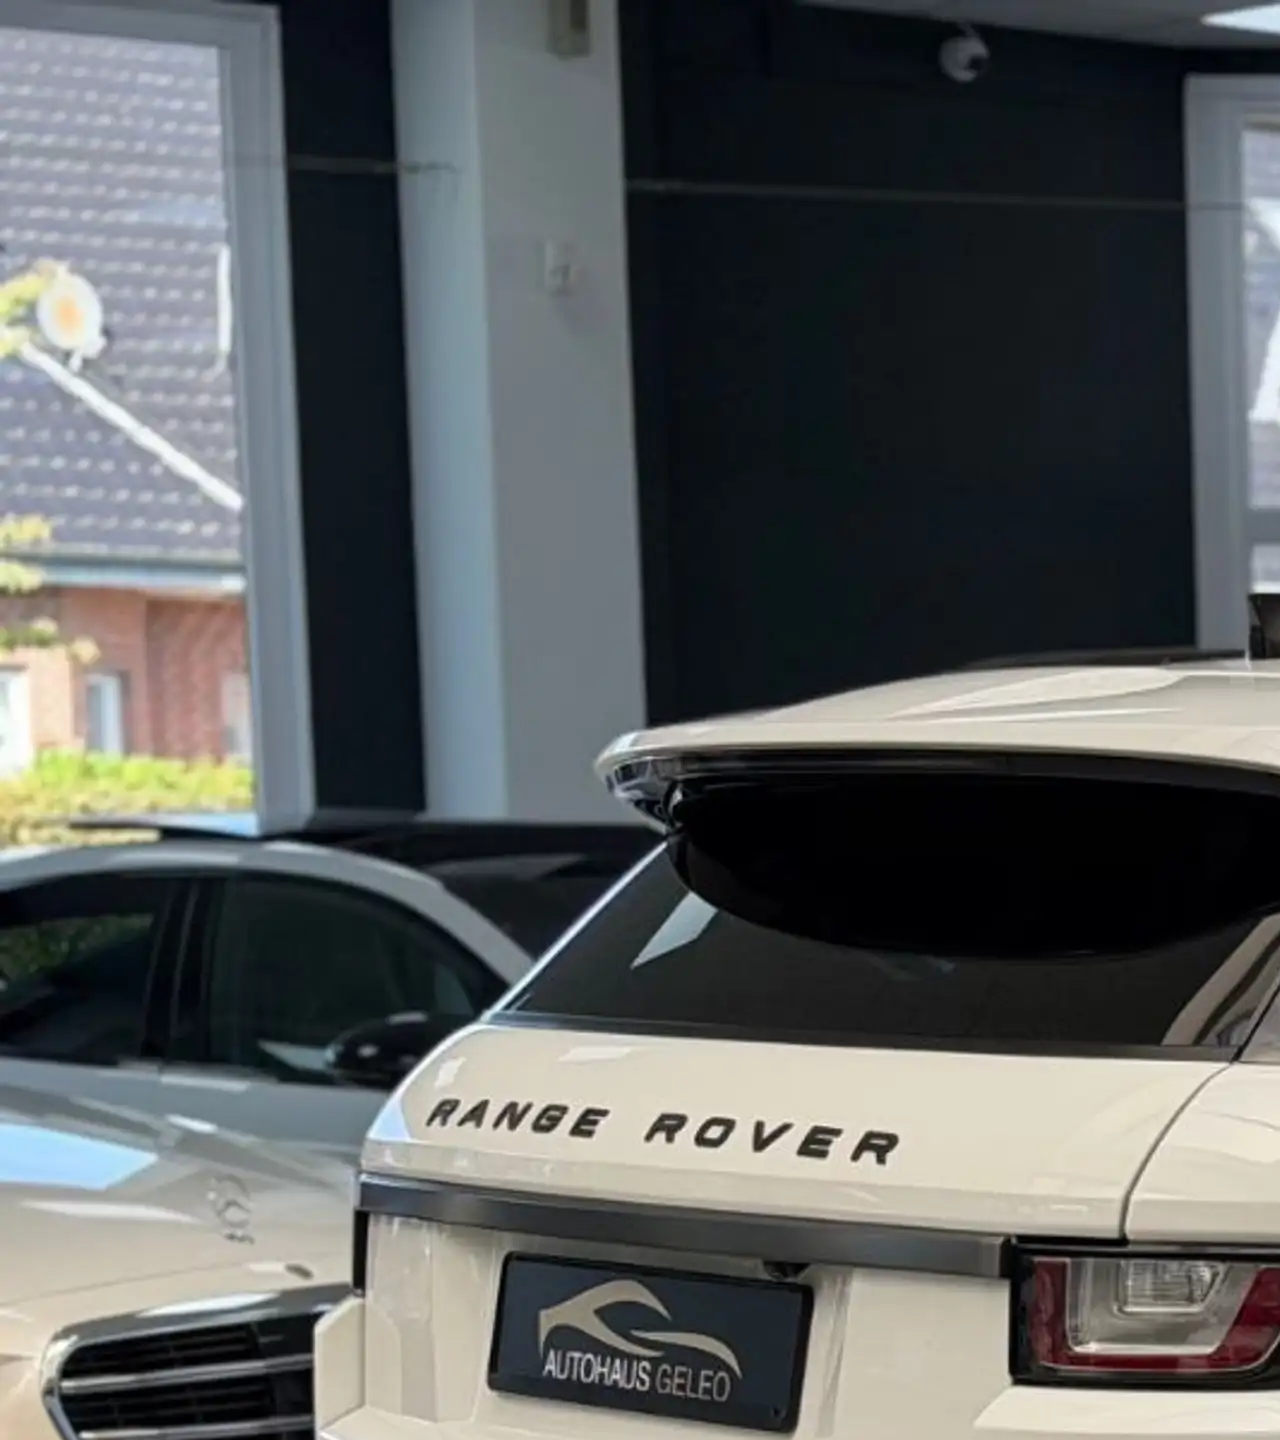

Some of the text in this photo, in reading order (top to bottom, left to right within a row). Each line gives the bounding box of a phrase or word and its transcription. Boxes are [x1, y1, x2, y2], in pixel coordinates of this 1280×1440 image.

[425, 1098, 900, 1166] RANGE ROVER
[543, 1348, 731, 1403] AUTOHAUS GELEO
